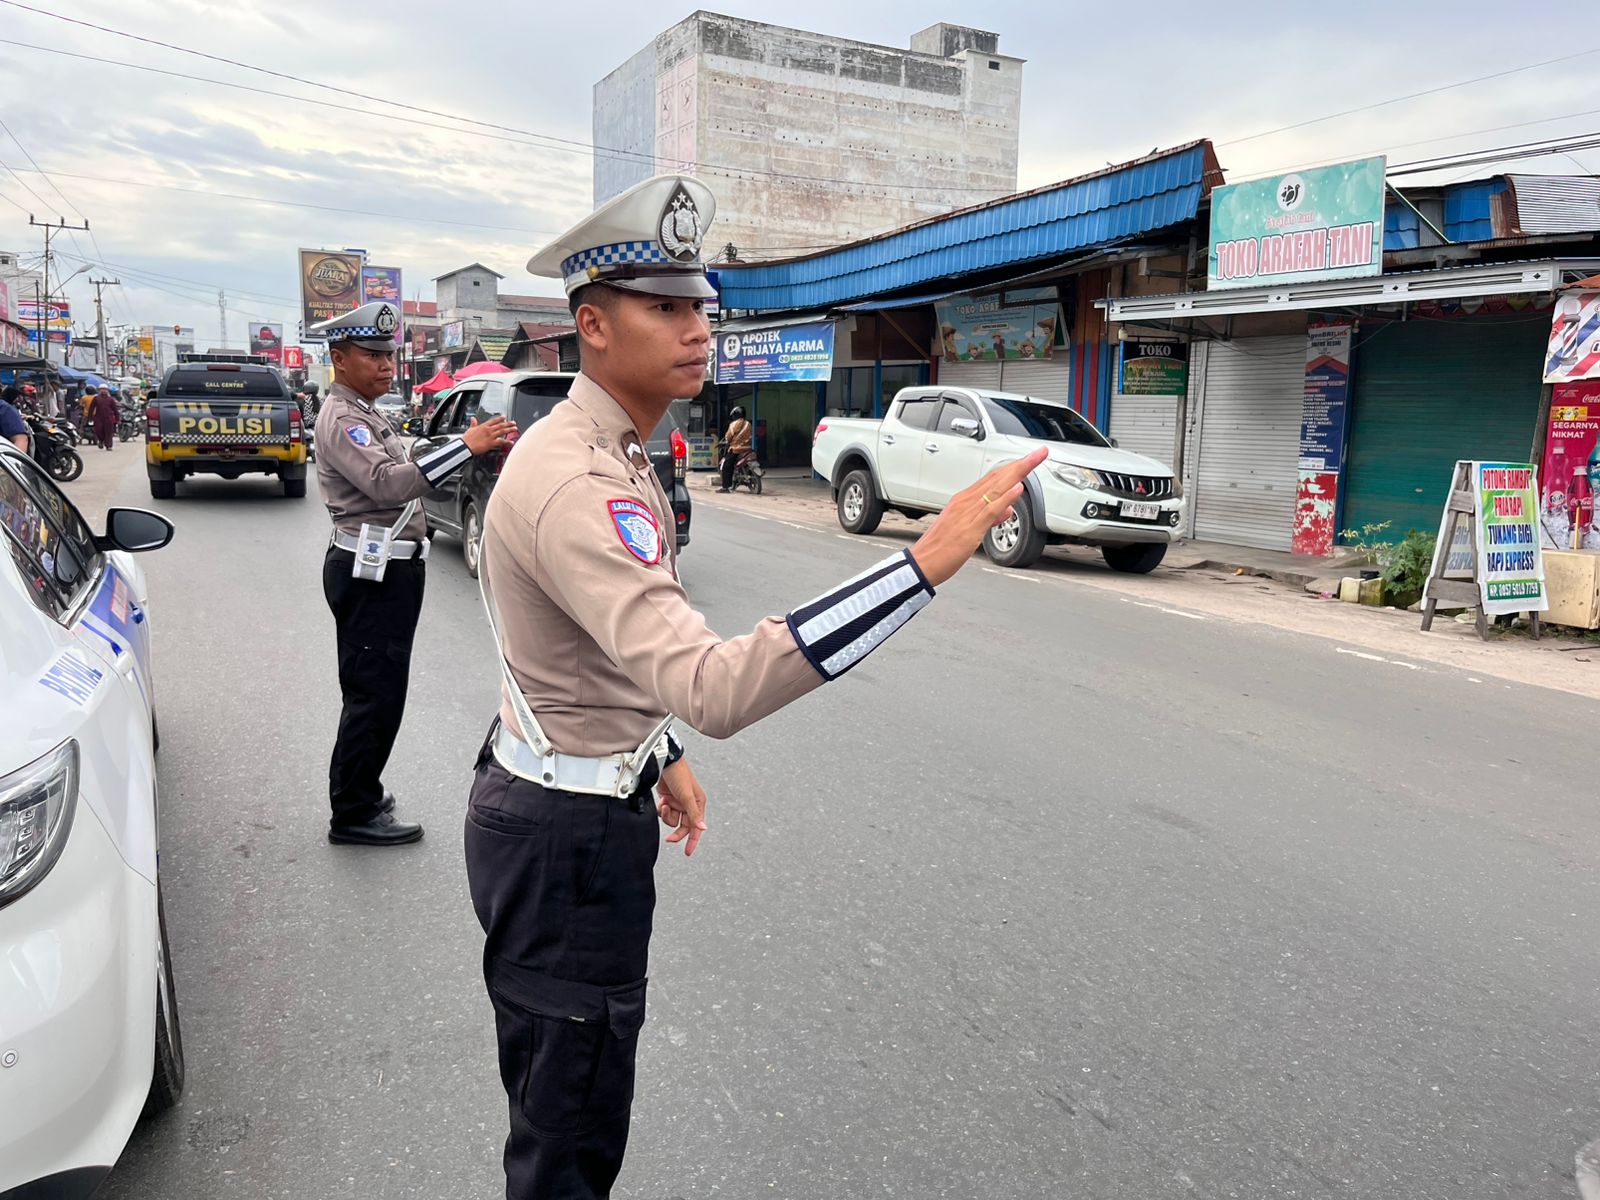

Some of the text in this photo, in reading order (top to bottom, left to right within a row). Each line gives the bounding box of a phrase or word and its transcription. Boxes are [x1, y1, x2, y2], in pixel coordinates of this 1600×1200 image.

[1216, 221, 1374, 280] TOKO ARAFAH TANI
[955, 304, 976, 314] TOKO
[742, 331, 781, 345] APOTEK
[742, 340, 825, 356] TRIJAYA FARMA
[1139, 344, 1172, 356] TOKO
[179, 417, 272, 435] POLISI
[1552, 421, 1599, 429] SEGARNYA
[1552, 431, 1585, 439] NIKMAT
[1483, 468, 1531, 490] POTONG RAMBUT
[1488, 524, 1533, 545] TUKANG GIGI
[1487, 550, 1534, 572] RAPI EXPRESS
